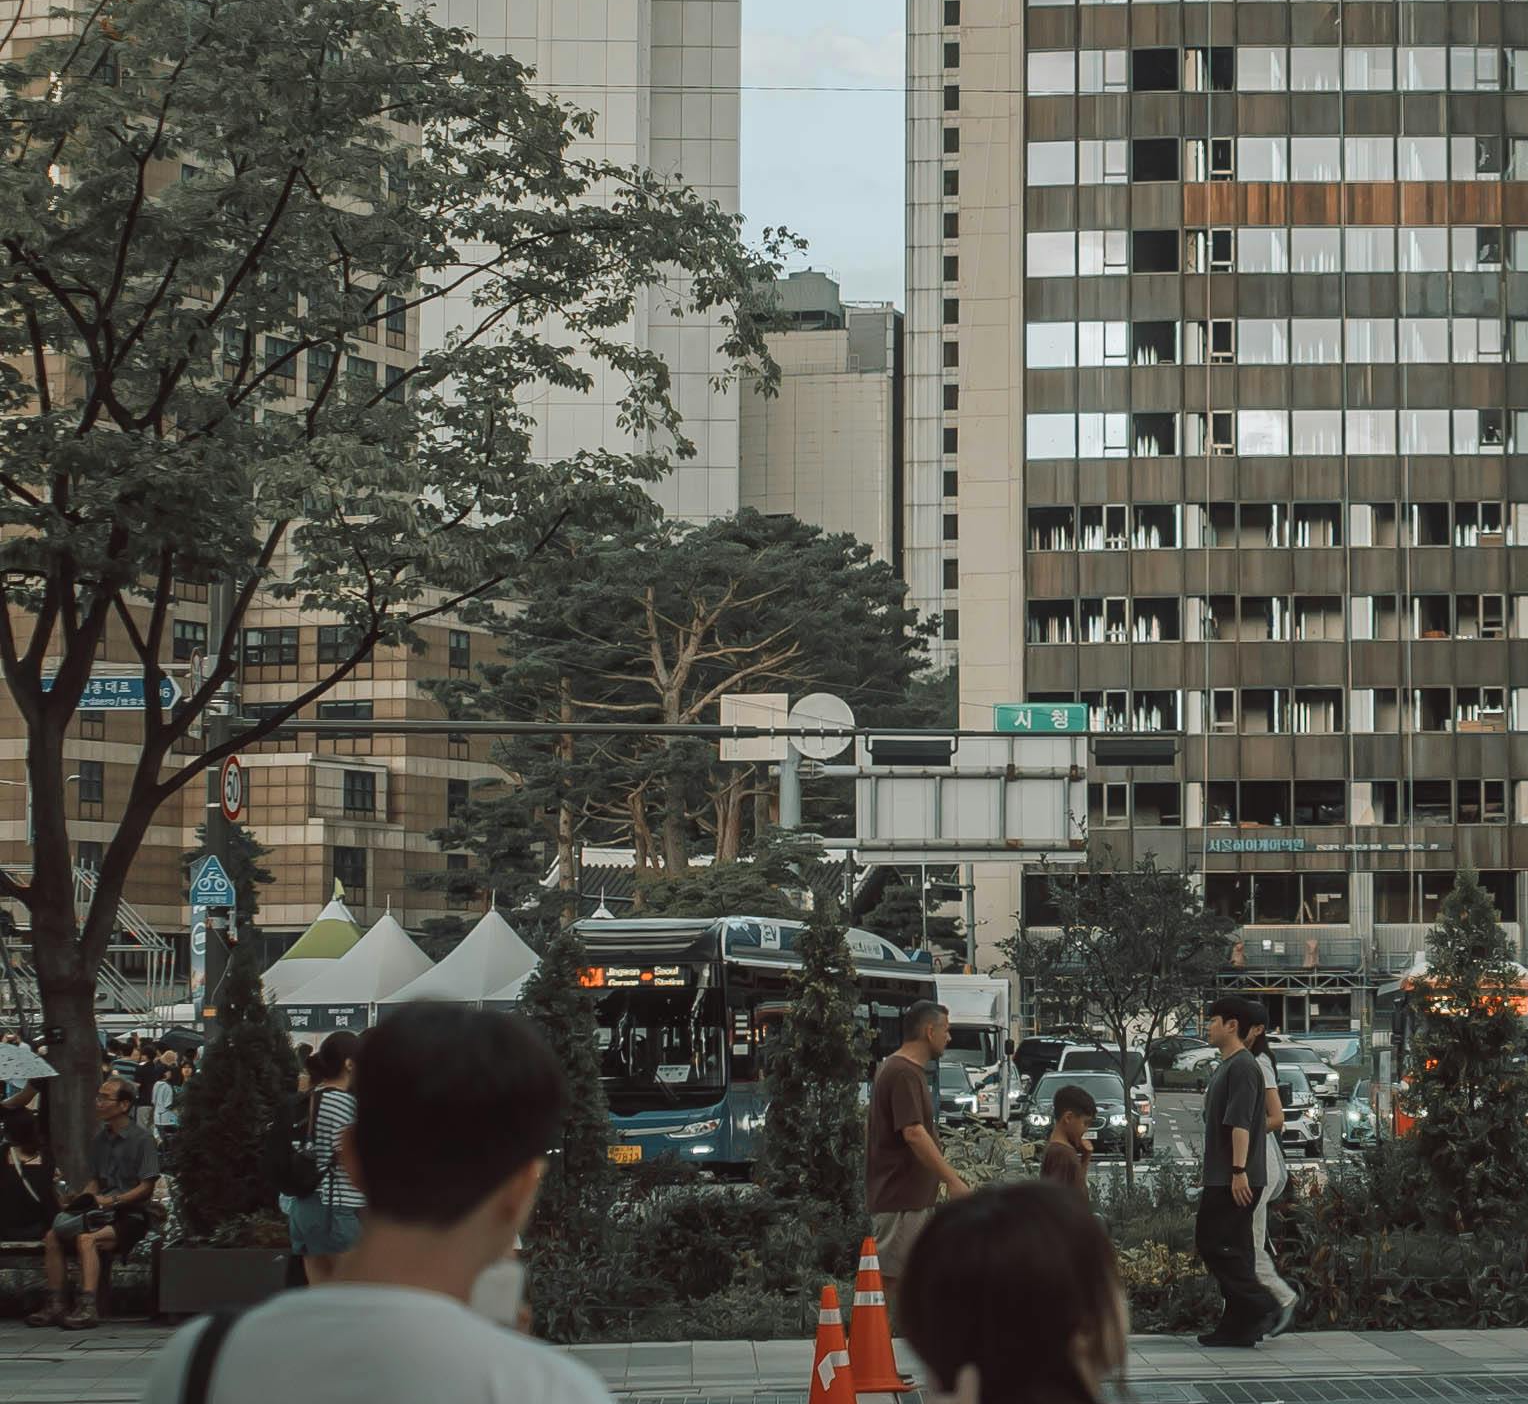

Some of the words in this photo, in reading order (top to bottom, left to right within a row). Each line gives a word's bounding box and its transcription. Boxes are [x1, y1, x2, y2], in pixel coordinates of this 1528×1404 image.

[1014, 709, 1069, 729] 시청
[226, 770, 238, 802] 50
[654, 966, 679, 975] Seoul
